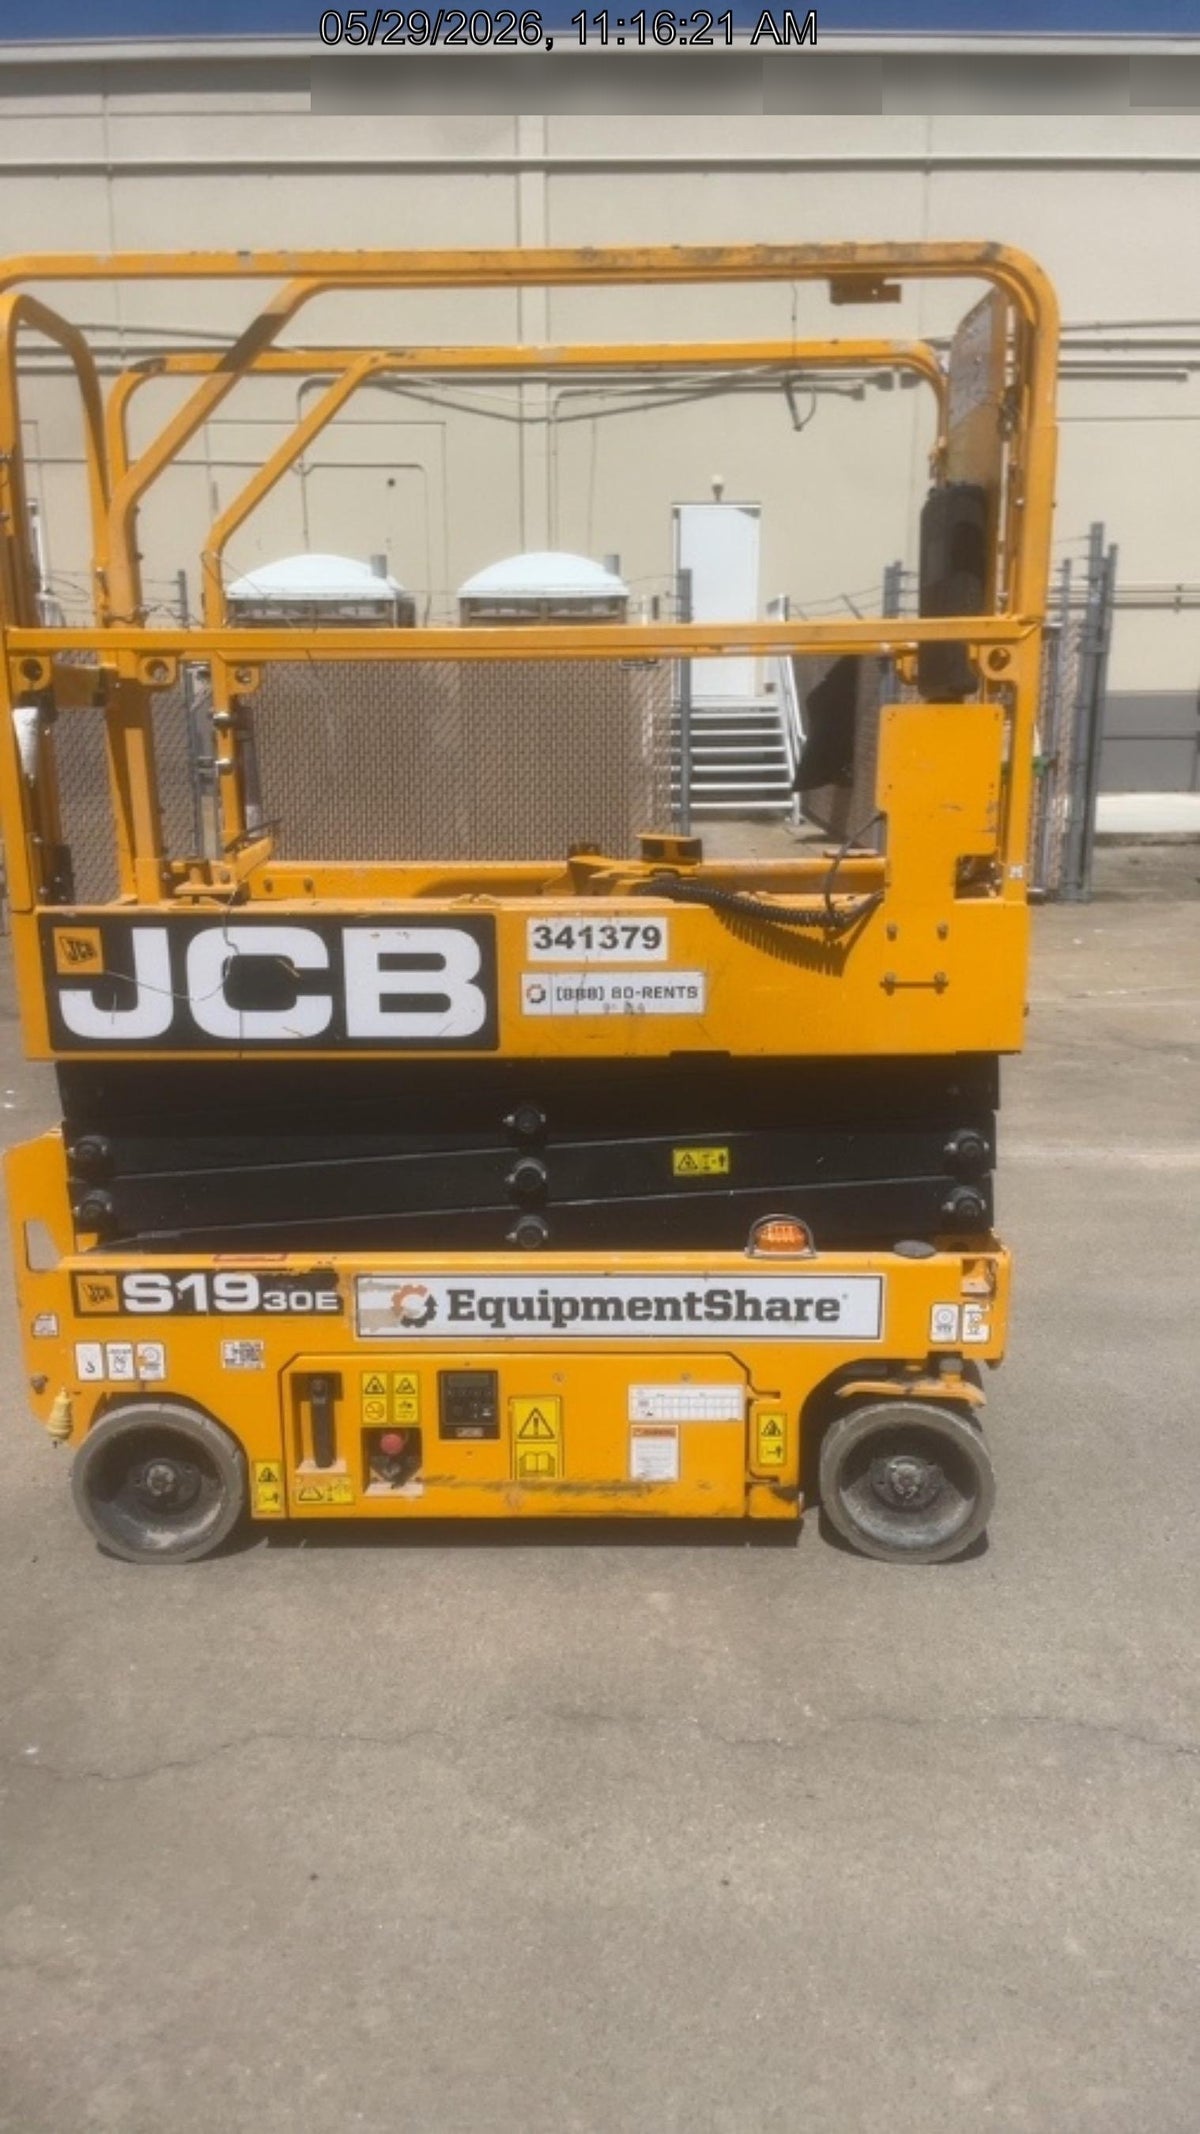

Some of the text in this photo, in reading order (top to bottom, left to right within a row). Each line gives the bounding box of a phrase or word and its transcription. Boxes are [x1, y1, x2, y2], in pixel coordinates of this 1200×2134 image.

[533, 924, 662, 949] 341379
[59, 926, 487, 1039] JCB
[446, 1289, 841, 1328] EquipmentShare
